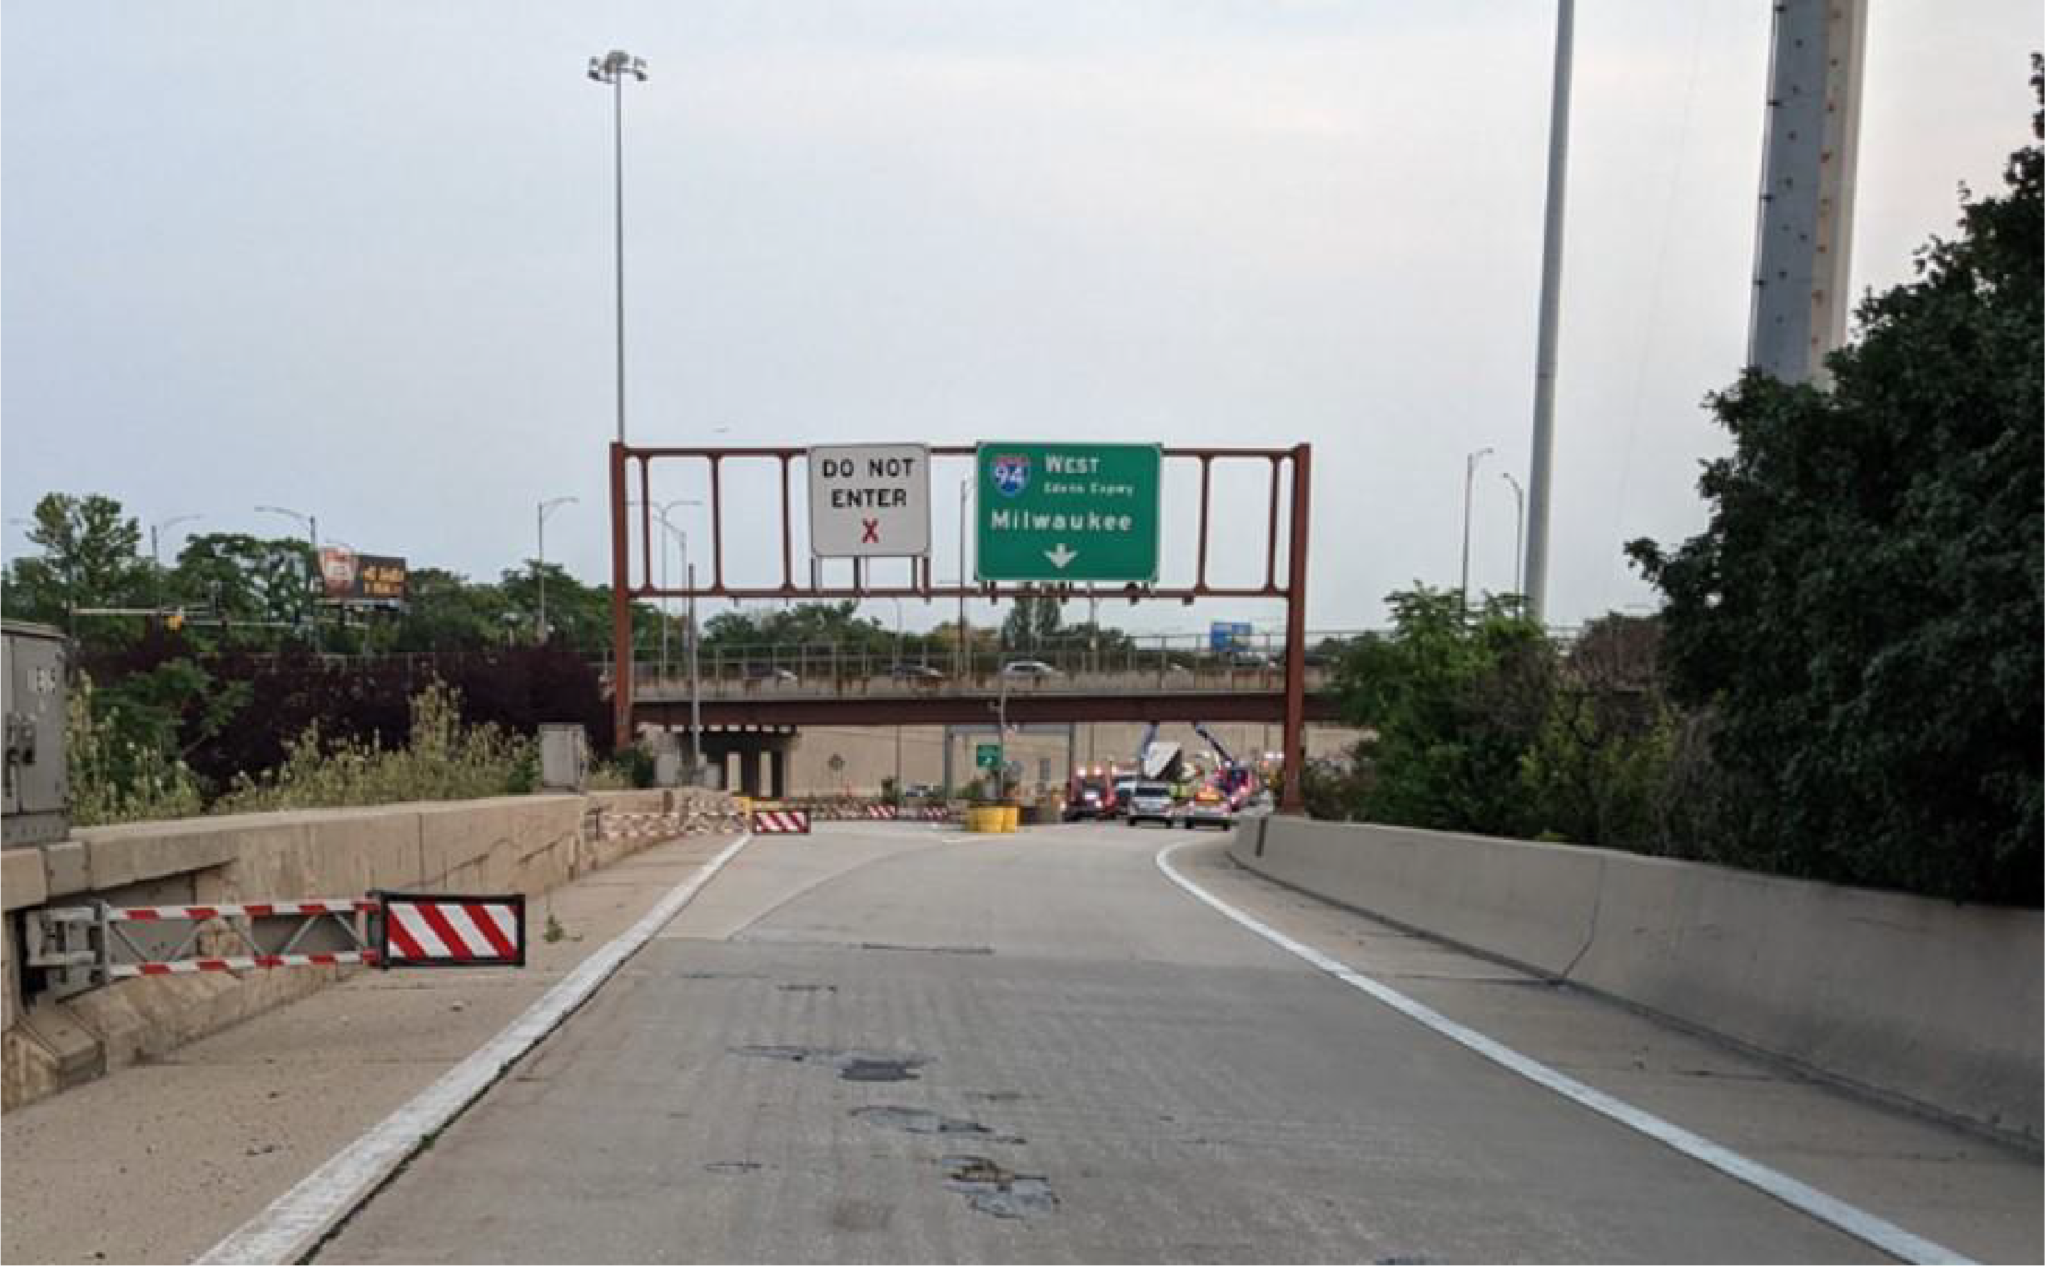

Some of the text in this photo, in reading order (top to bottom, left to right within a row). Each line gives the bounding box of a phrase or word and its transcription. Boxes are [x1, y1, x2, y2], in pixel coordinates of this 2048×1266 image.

[822, 457, 915, 478] DO NOT
[1045, 453, 1100, 474] WEST
[994, 466, 1025, 485] 94
[831, 488, 907, 508] ENTER
[991, 509, 1133, 531] Milwaukee
